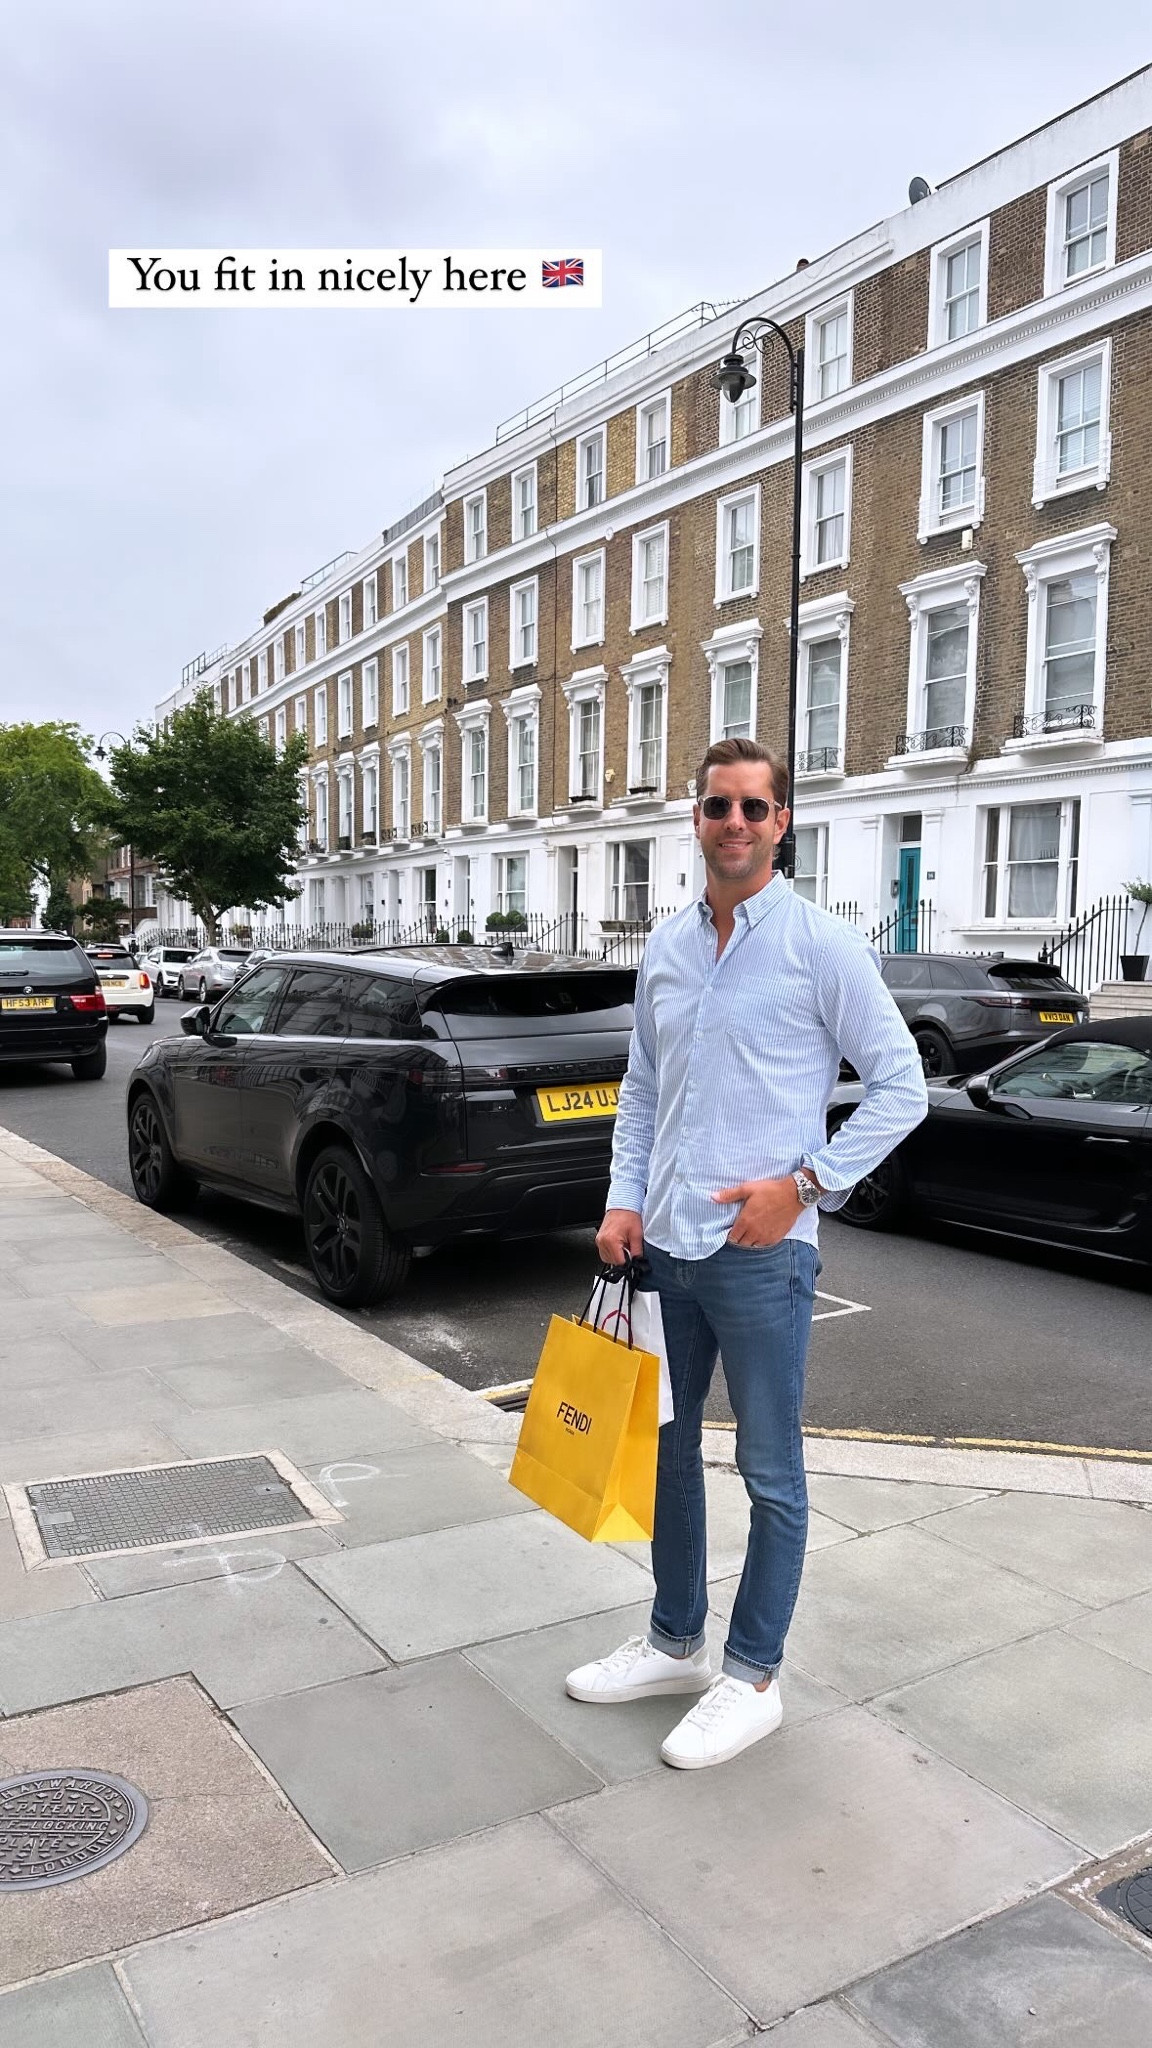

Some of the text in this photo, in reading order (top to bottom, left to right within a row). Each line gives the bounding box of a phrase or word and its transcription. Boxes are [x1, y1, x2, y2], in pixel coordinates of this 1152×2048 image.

[546, 1086, 620, 1113] LJ24 UJ
[556, 1401, 592, 1435] FENDI
[1, 1777, 119, 1801] HAYWARD'S
[16, 1803, 91, 1814] PATENT
[0, 1820, 109, 1831] F-LOCKING
[0, 1837, 63, 1848] PLATE
[31, 1838, 112, 1875] LONDON
